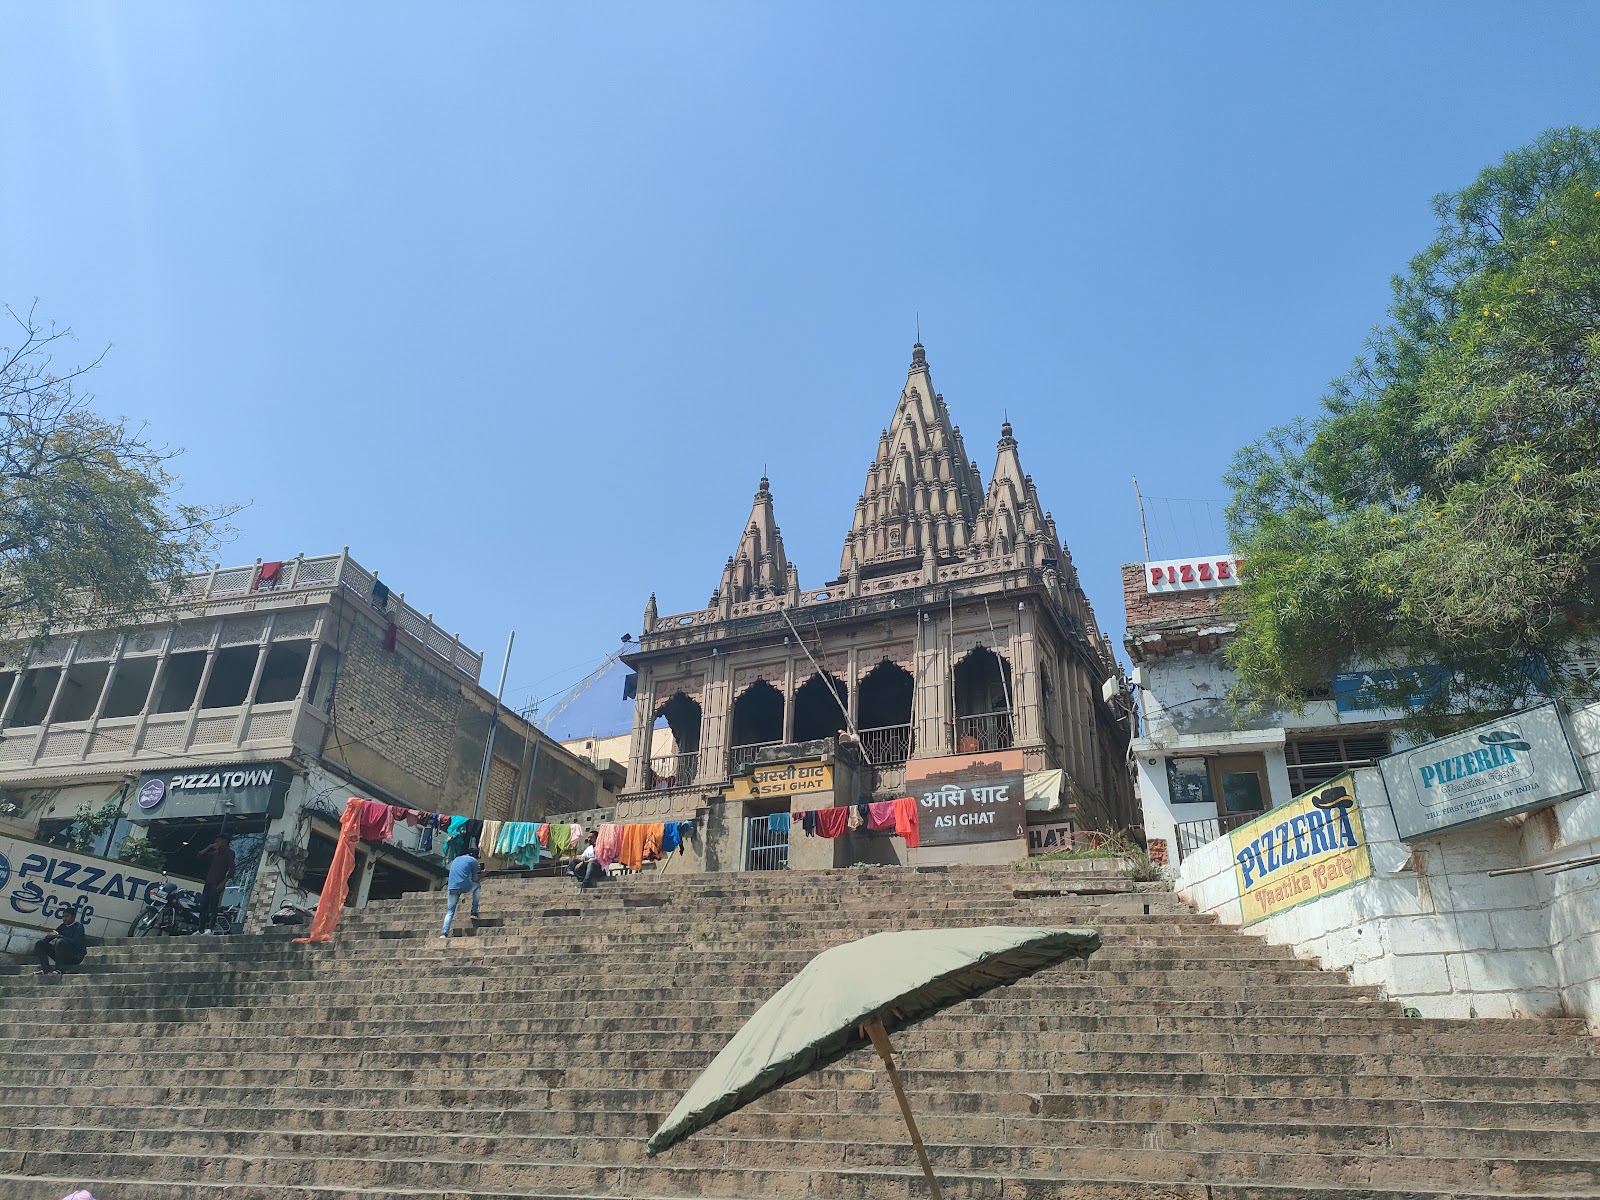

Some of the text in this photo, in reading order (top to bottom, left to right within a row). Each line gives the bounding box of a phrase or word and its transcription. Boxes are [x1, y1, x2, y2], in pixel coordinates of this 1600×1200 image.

[798, 766, 824, 779] घाट
[1419, 743, 1517, 789] PIZZERIA
[749, 779, 824, 795] ASSI GHAT
[920, 784, 1010, 808] असि घाट
[1425, 811, 1441, 820] THE
[1442, 803, 1464, 816] FIRST
[1465, 793, 1502, 810] PIZZERIA
[1503, 790, 1514, 798] OF
[1516, 782, 1540, 794] INDIA
[934, 811, 996, 828] ASI GHAT
[1236, 807, 1358, 889] PIZZERIA
[1255, 873, 1312, 913] Vaatika
